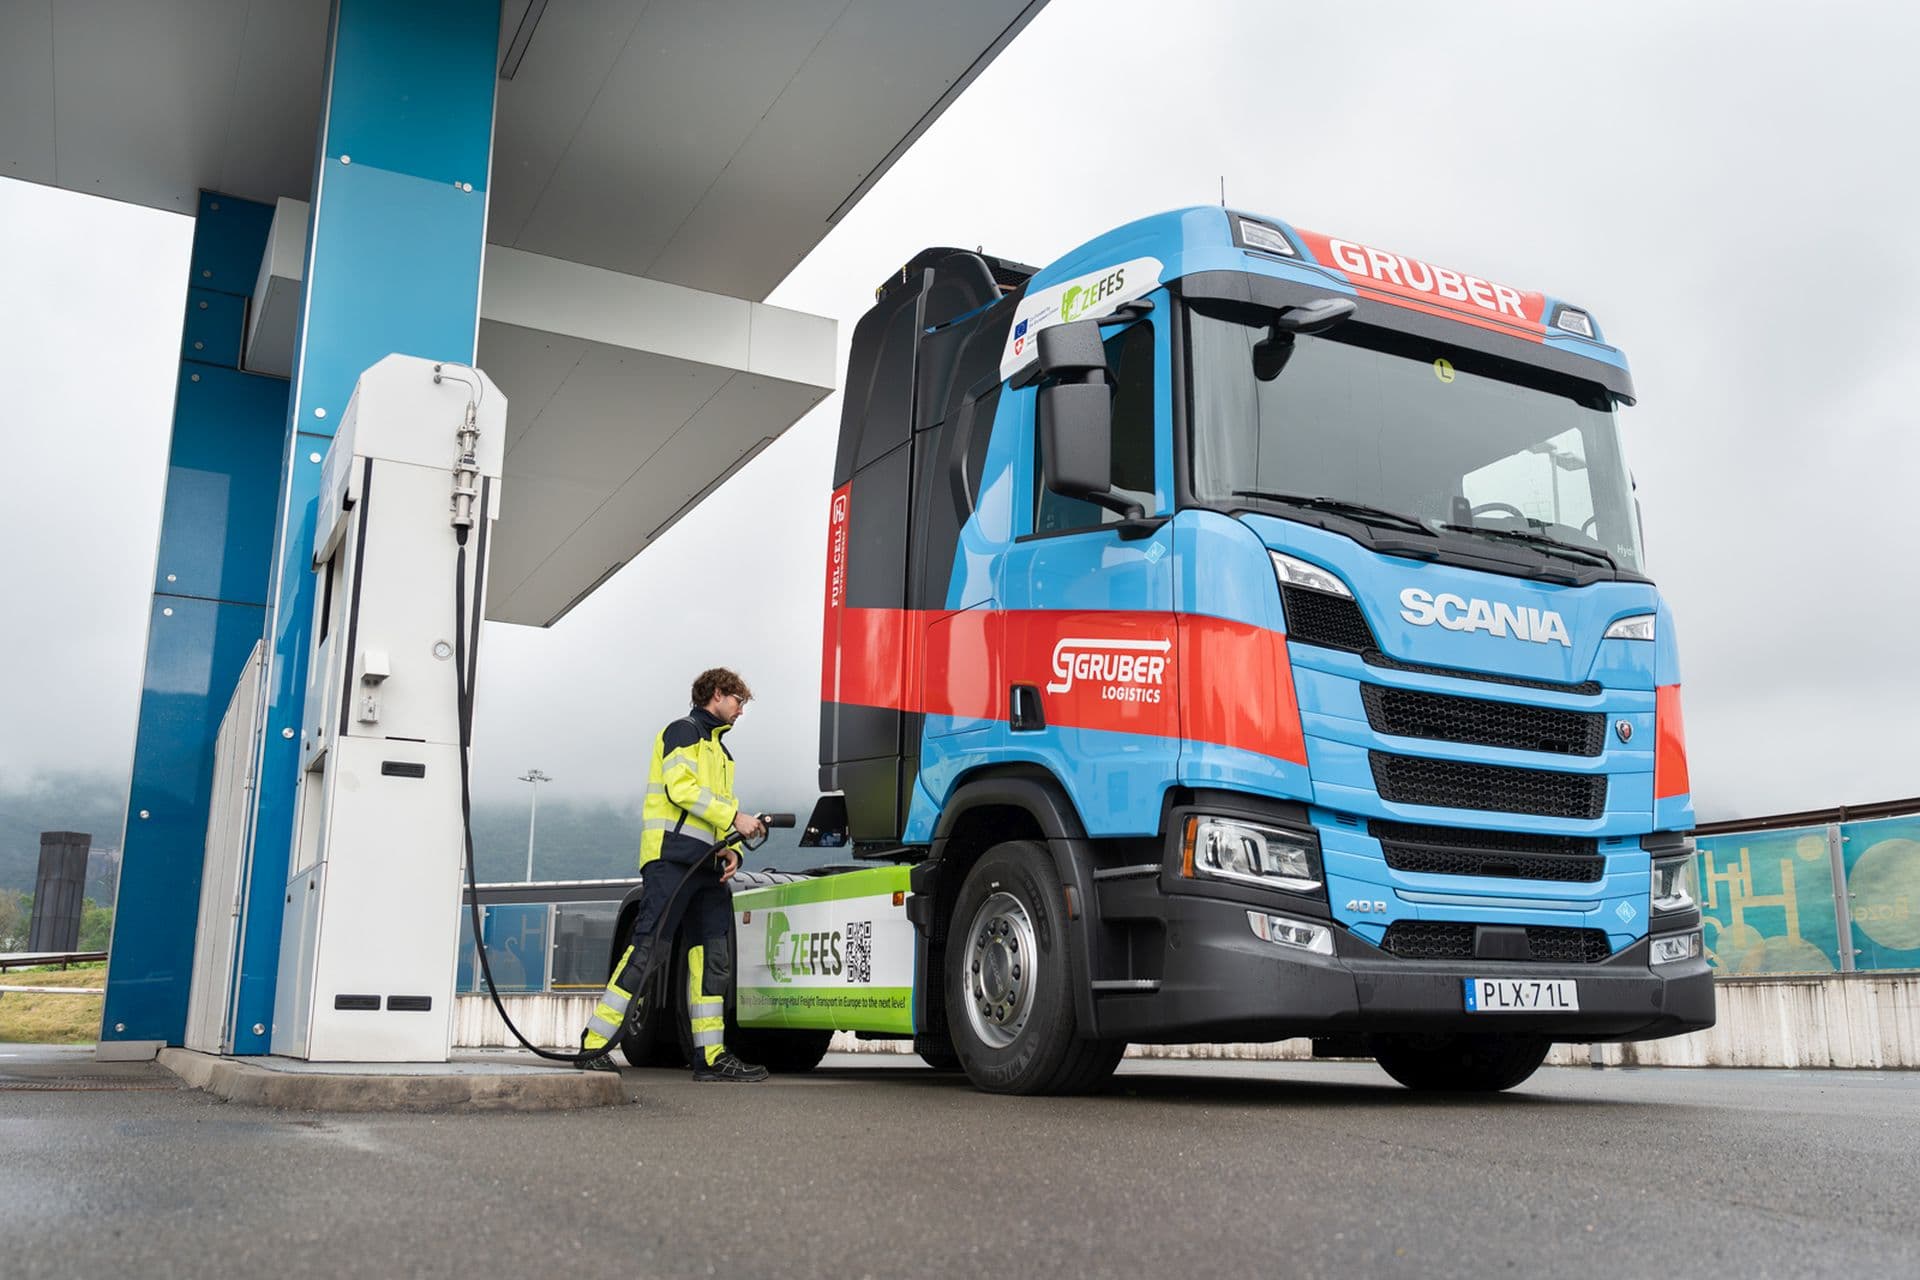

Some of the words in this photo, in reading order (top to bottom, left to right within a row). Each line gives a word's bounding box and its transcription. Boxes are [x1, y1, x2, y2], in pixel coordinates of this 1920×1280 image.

[1081, 268, 1125, 311] ZEFES
[1329, 238, 1527, 320] GRUBER
[833, 525, 842, 564] CELL
[831, 566, 840, 608] FUEL
[1399, 587, 1571, 647] SCANIA
[1074, 652, 1165, 685] GRUBER
[1102, 685, 1161, 704] LOGISTICS
[1345, 899, 1371, 913] 40
[1373, 900, 1387, 914] R
[791, 931, 842, 975] ZEFES
[844, 996, 861, 1009] Europe
[869, 996, 877, 1008] the
[879, 998, 890, 1008] next
[1484, 982, 1525, 1007] PLX
[1530, 983, 1569, 1007] 71L
